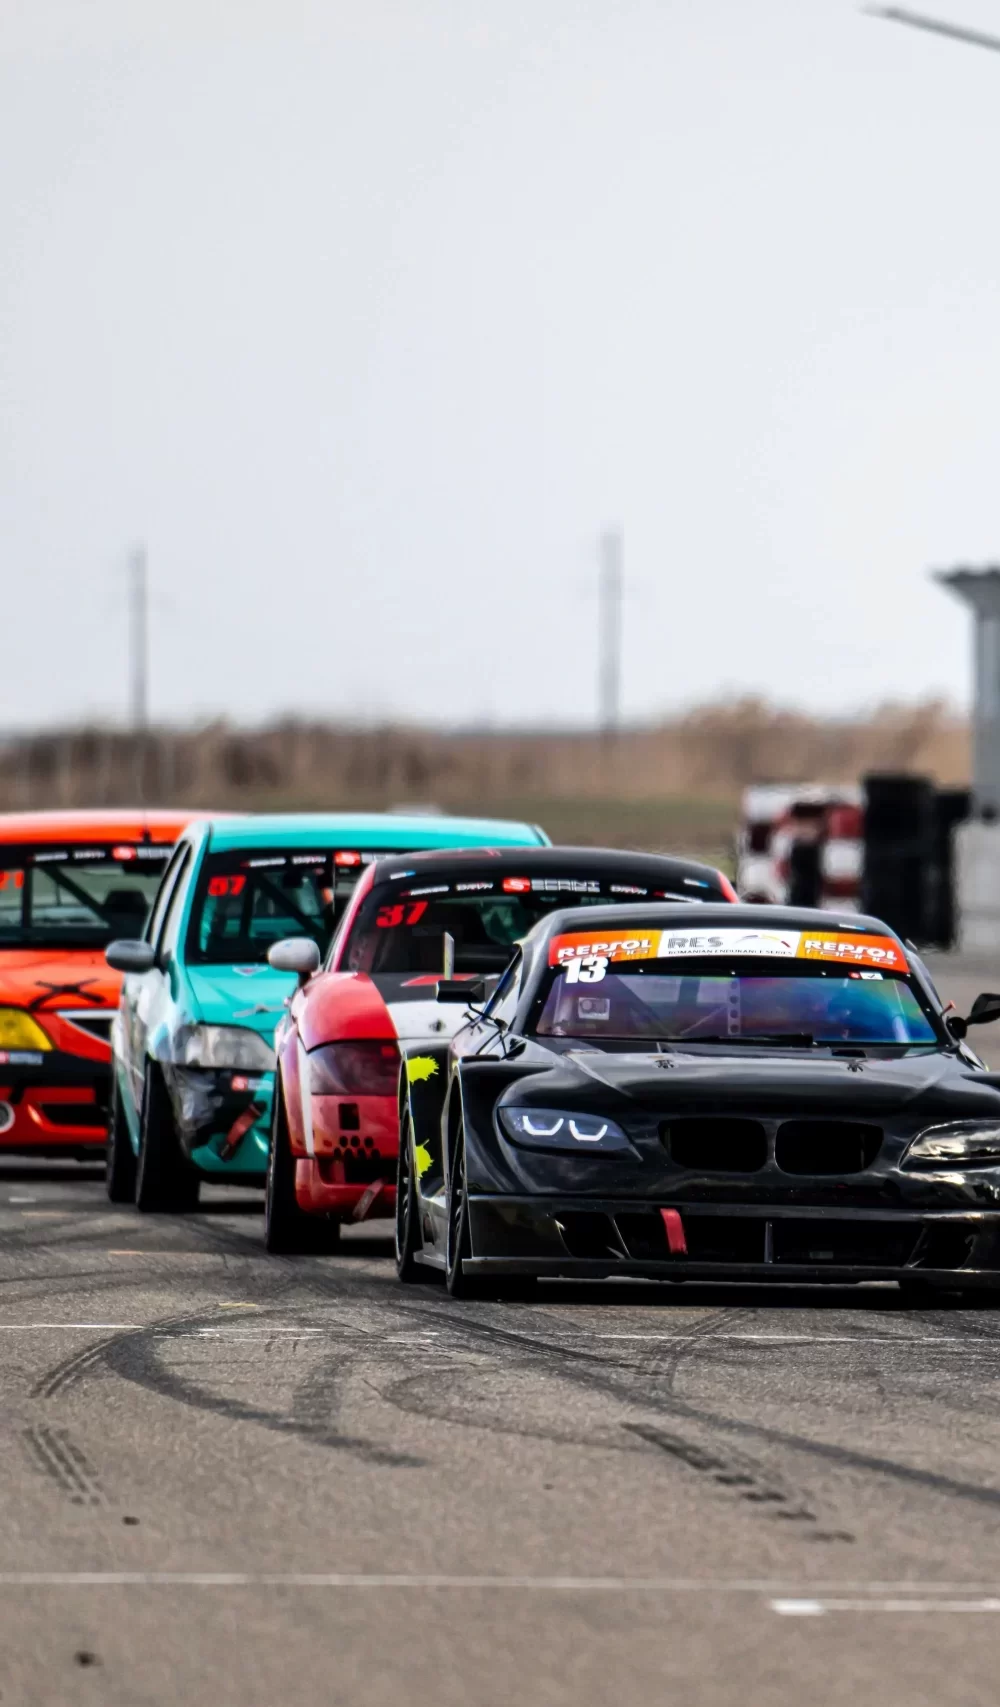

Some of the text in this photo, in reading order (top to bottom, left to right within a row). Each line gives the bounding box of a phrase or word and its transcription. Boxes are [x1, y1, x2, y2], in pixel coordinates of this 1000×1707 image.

[376, 901, 428, 928] 37
[557, 939, 653, 958] REPSOL
[668, 936, 723, 948] RES
[804, 940, 897, 960] REPSOL
[560, 956, 609, 984] 13
